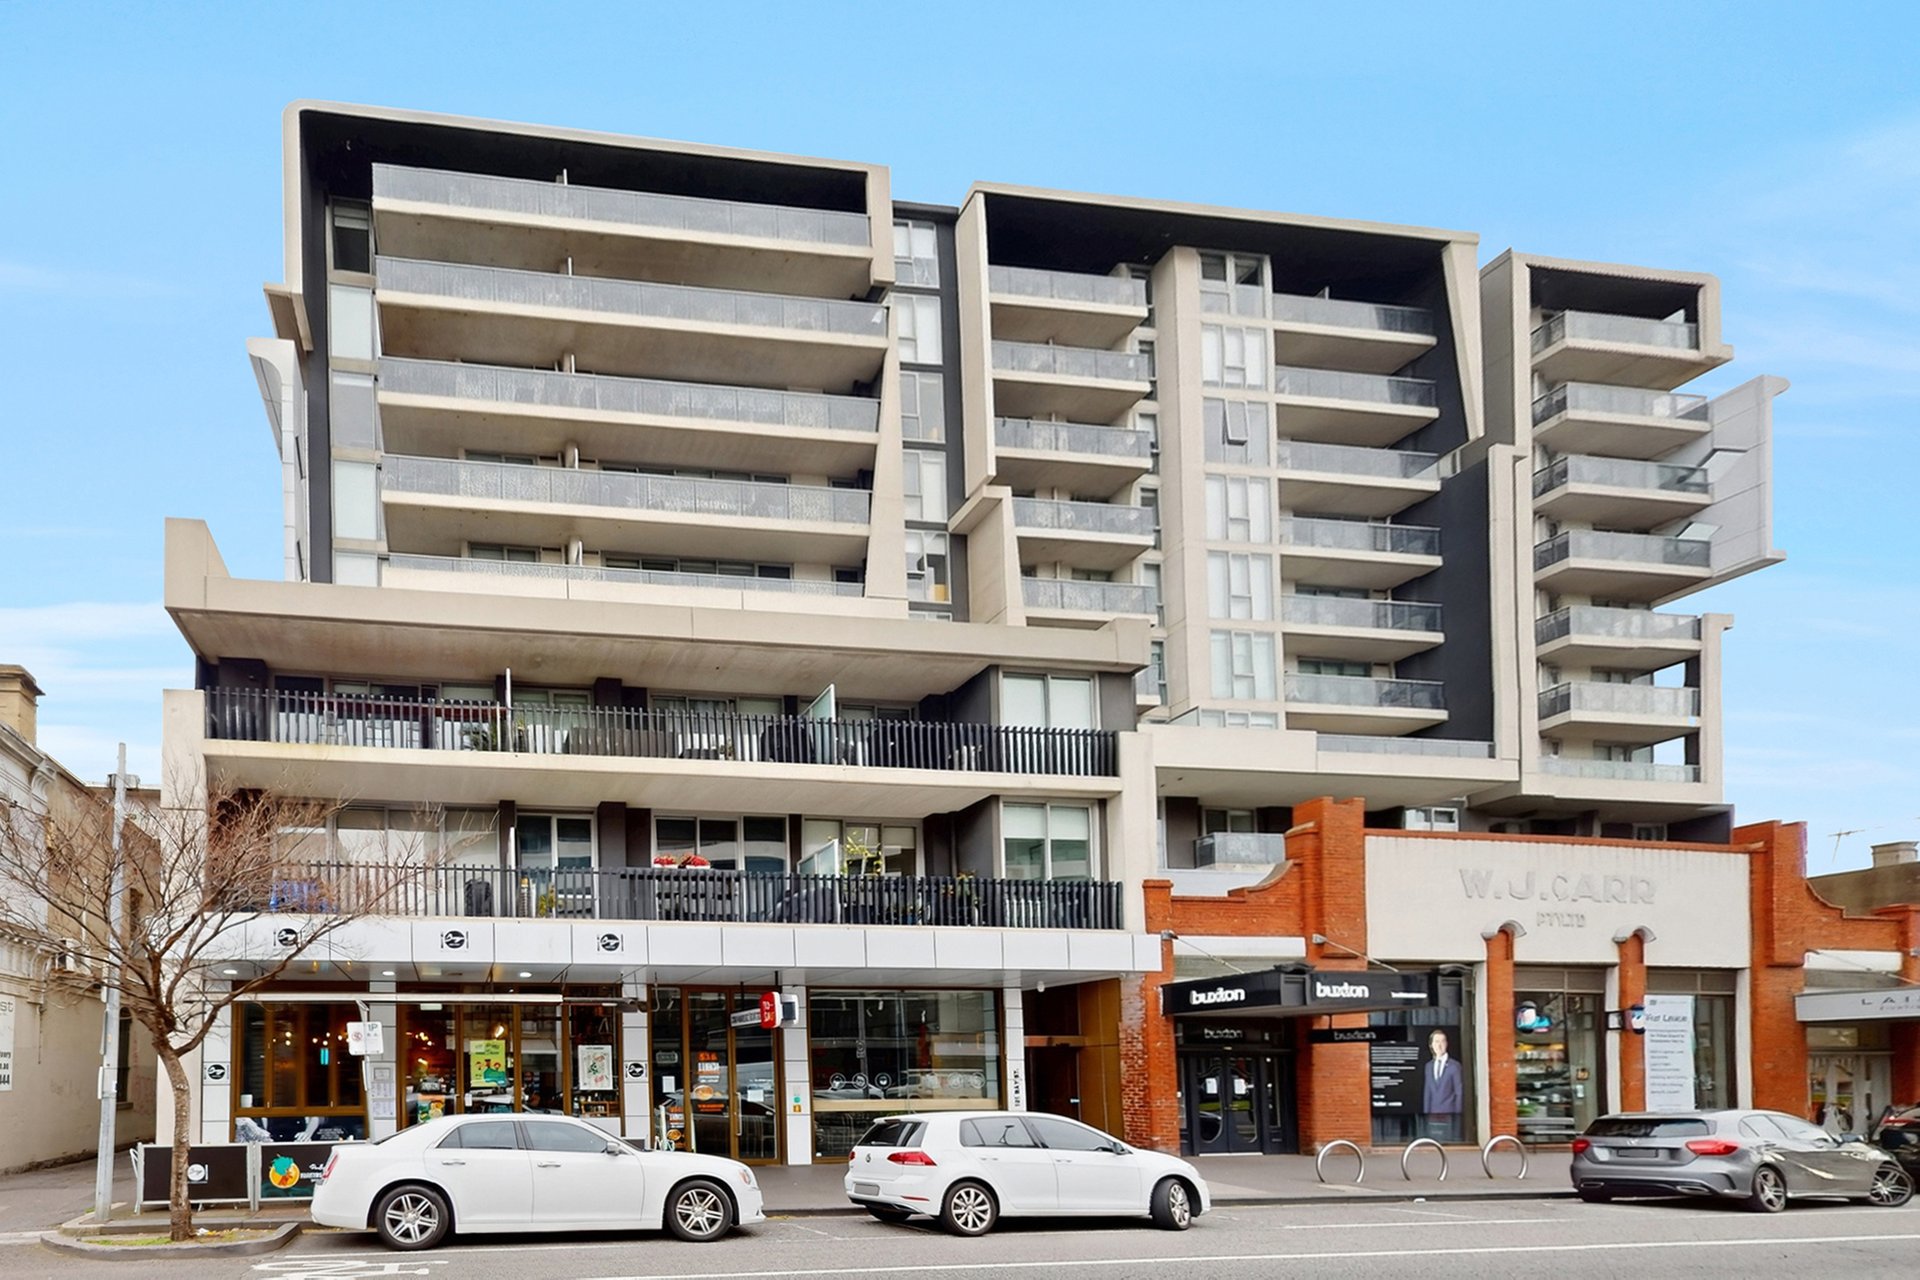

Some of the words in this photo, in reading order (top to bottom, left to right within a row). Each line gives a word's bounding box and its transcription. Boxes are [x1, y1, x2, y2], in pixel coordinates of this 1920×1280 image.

[1189, 987, 1246, 1005] buxton
[1316, 982, 1369, 998] buxton
[1204, 1027, 1243, 1039] buxton
[1334, 1030, 1377, 1040] buxton
